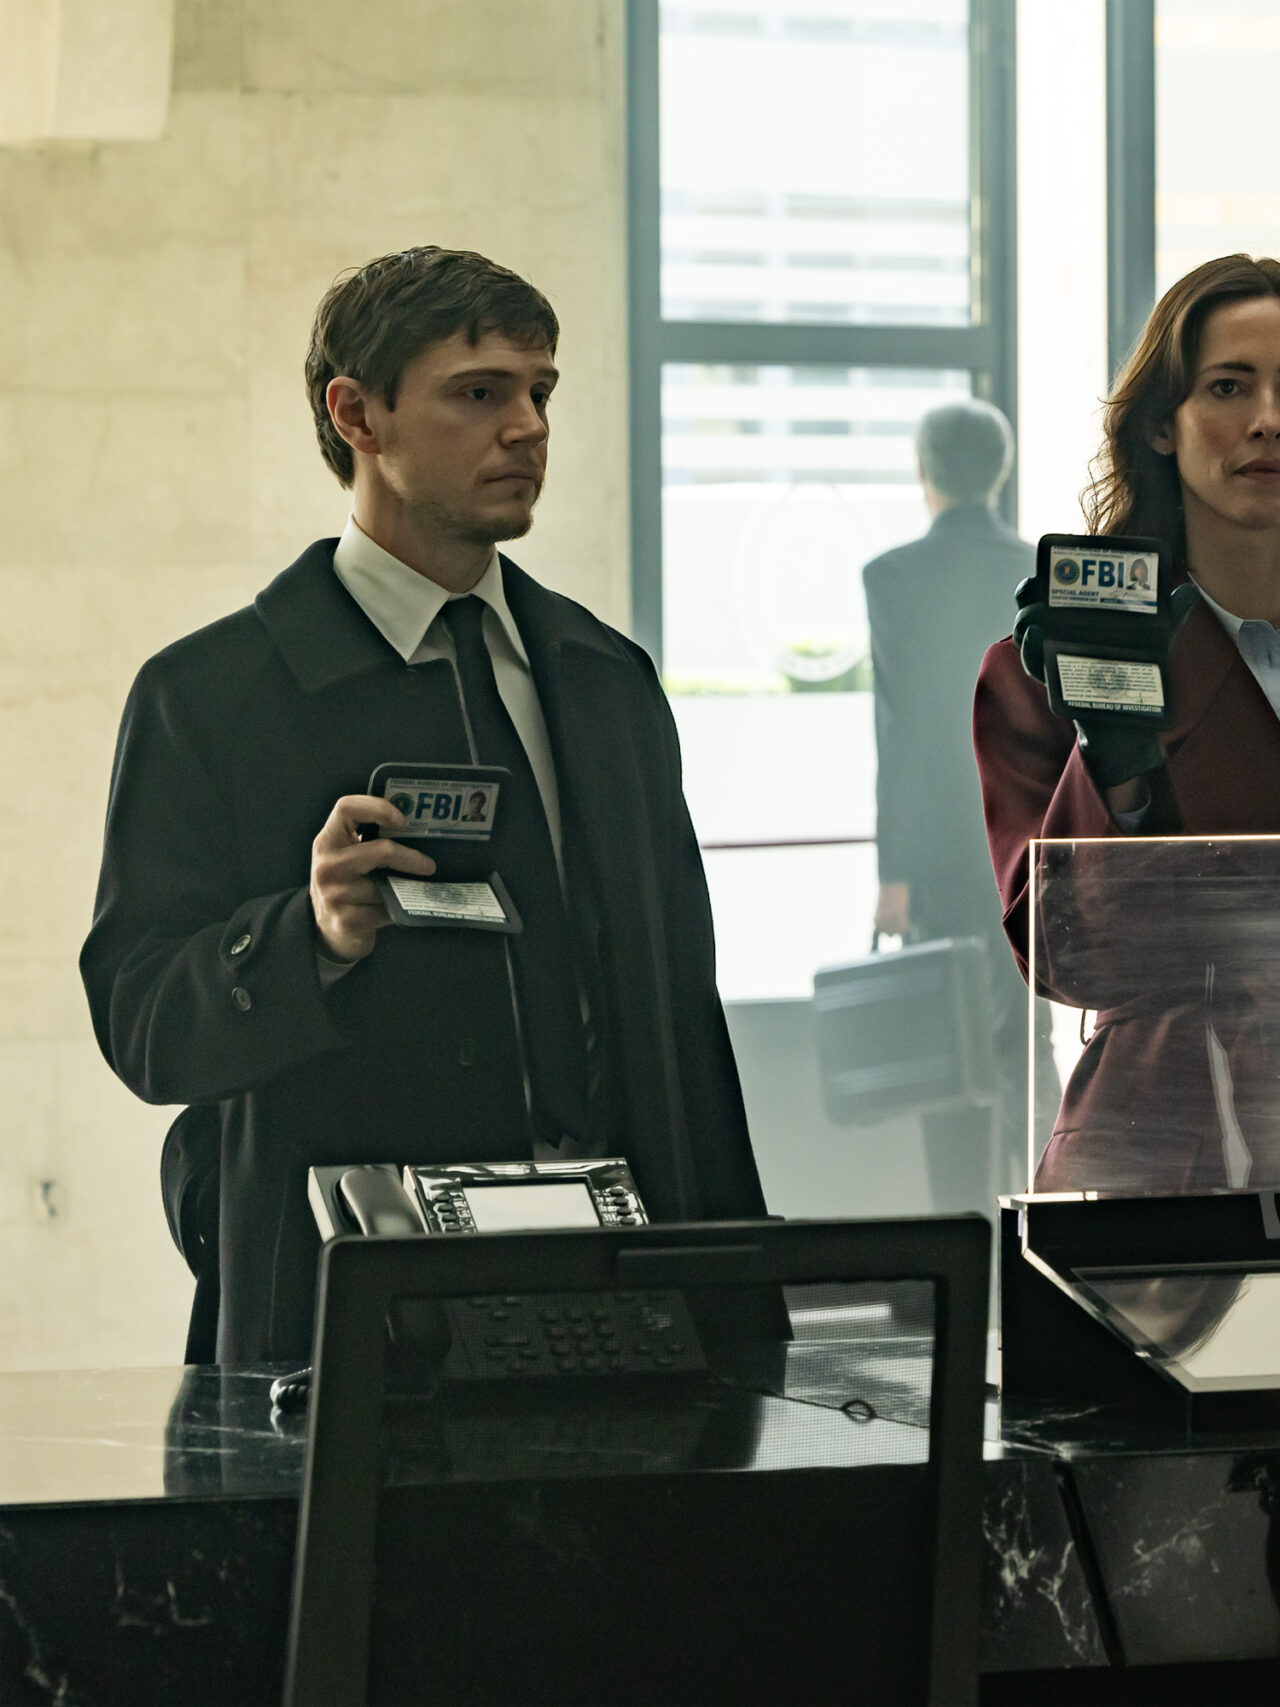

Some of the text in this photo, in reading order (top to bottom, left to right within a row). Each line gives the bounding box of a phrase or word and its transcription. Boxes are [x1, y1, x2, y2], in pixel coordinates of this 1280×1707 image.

[1082, 559, 1125, 588] FBI
[1114, 703, 1122, 711] OF
[415, 792, 463, 820] FBI
